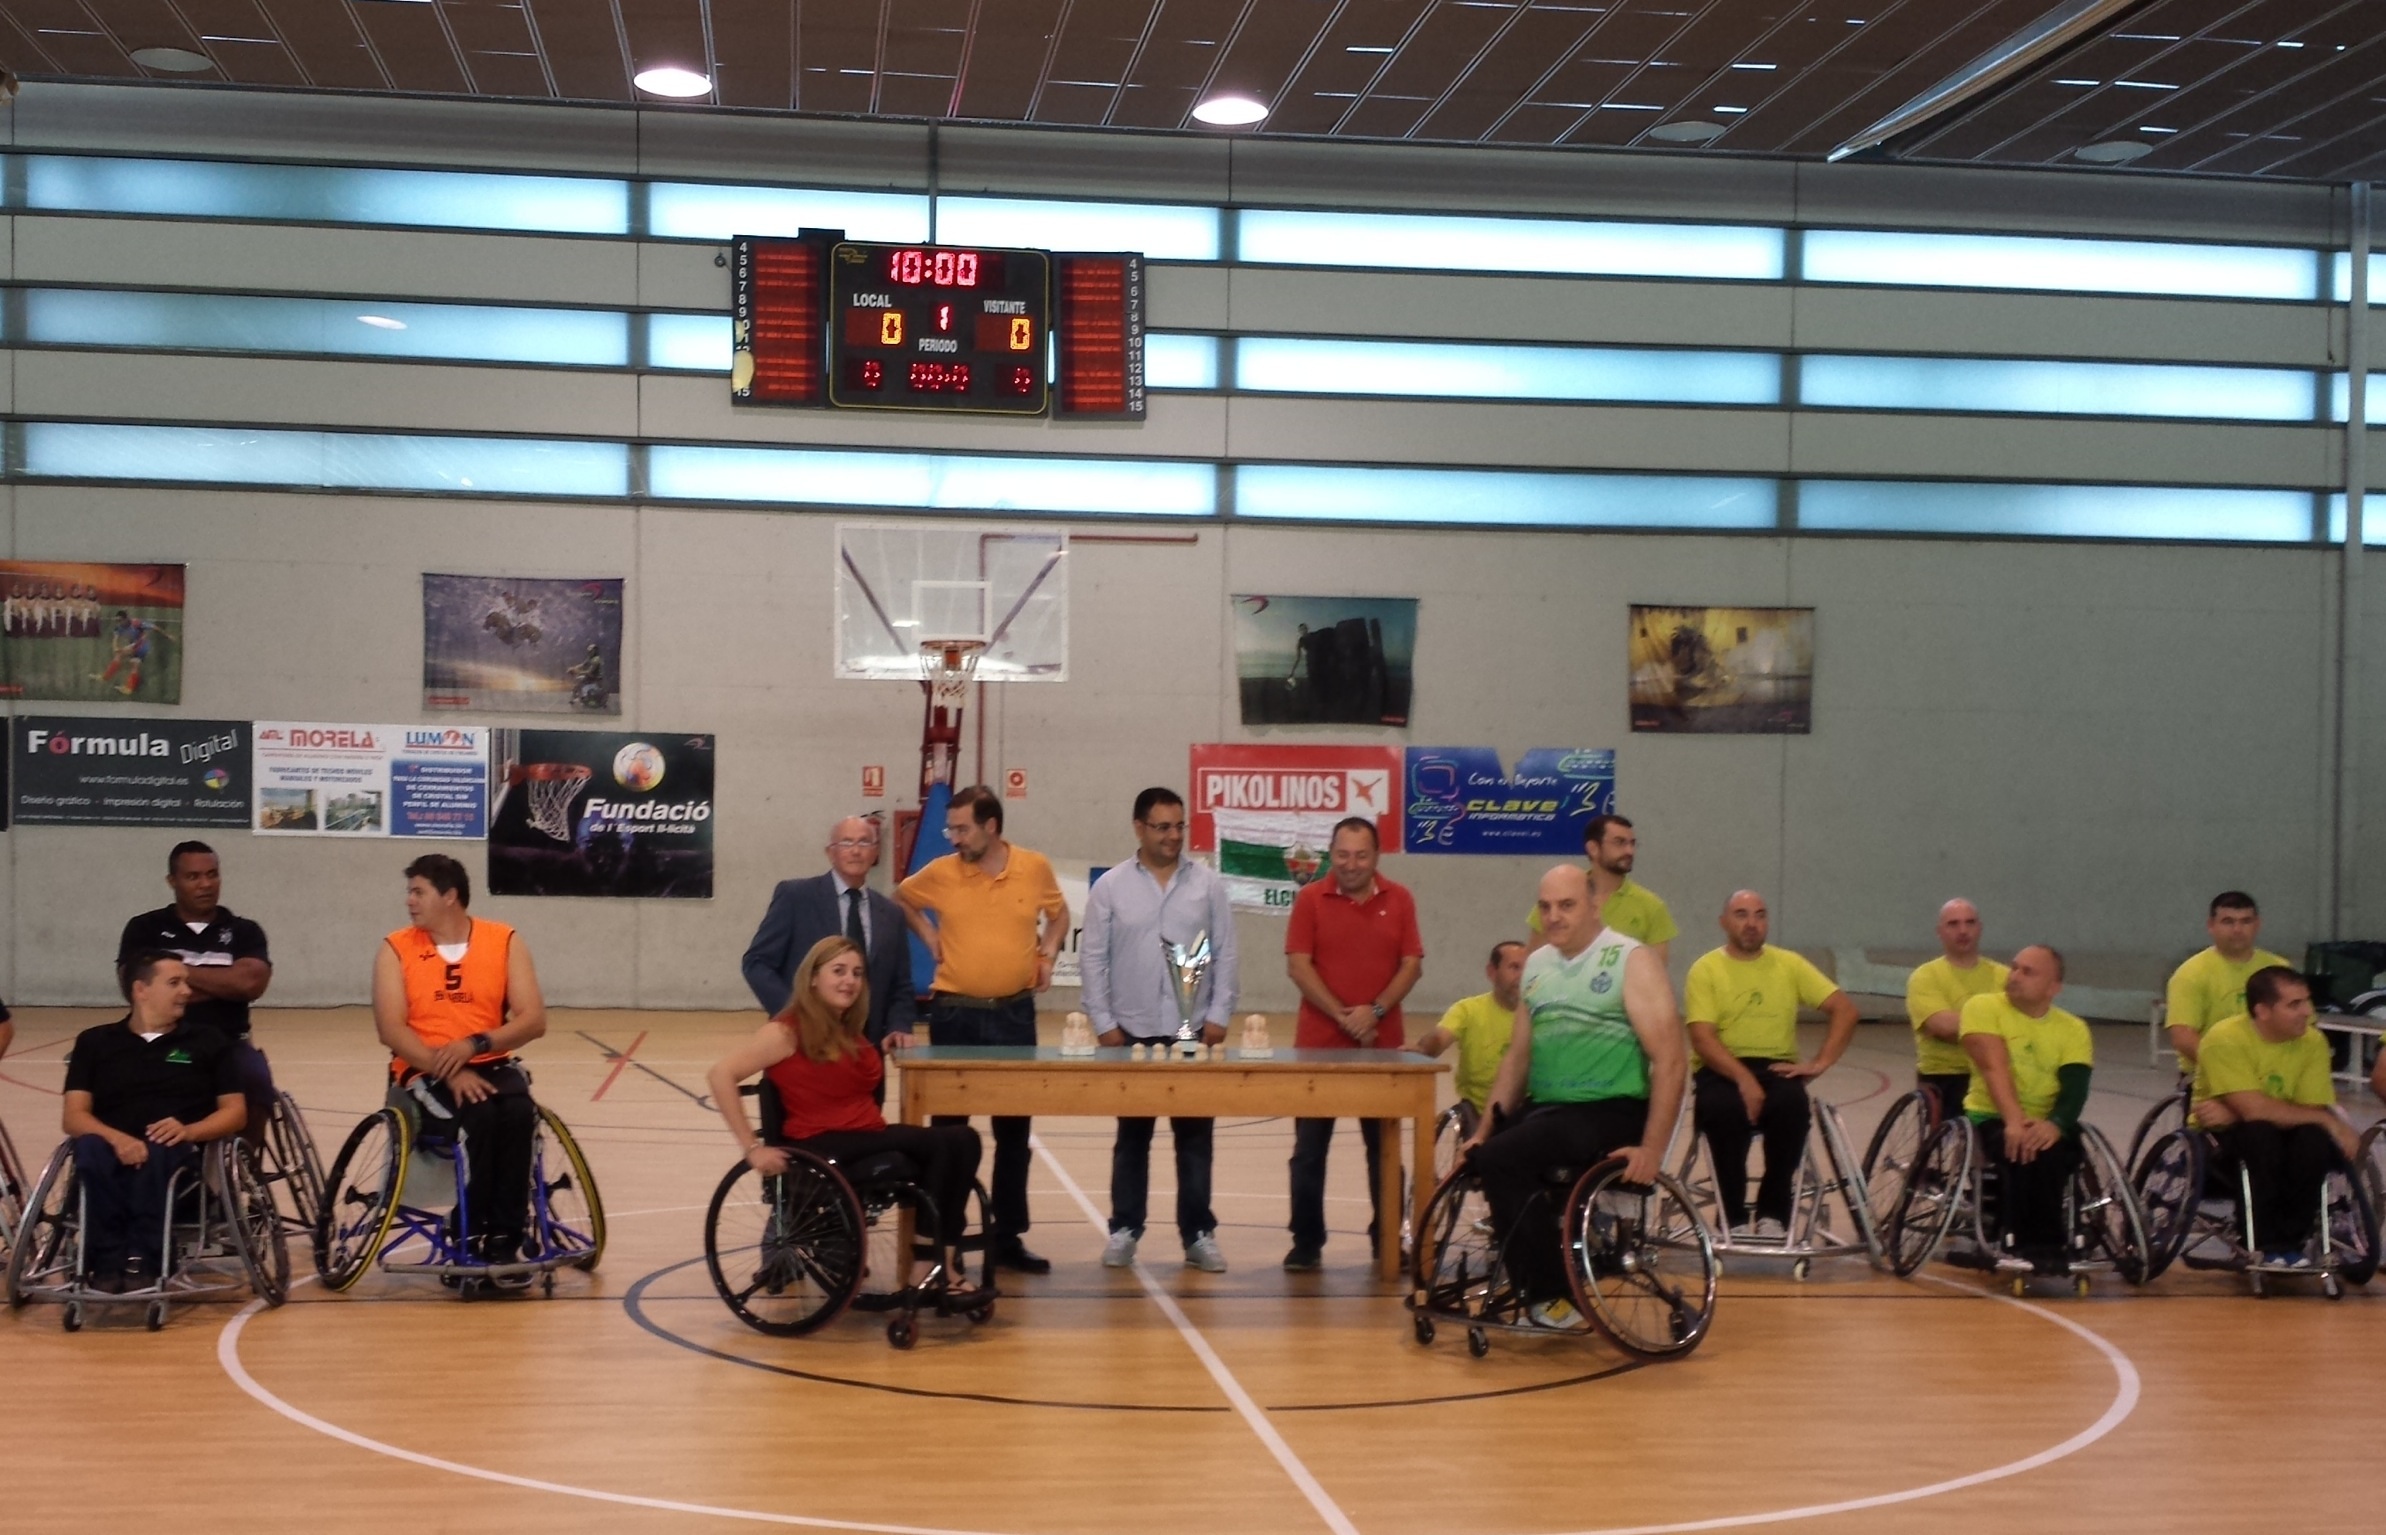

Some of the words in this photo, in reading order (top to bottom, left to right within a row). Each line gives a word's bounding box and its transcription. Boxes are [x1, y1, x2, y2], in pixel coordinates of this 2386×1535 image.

[739, 242, 747, 252] 4
[739, 255, 747, 265] 5
[1129, 258, 1137, 269] 4
[739, 268, 746, 278] 6
[890, 251, 978, 286] 10:00
[1131, 271, 1138, 281] 5
[739, 281, 747, 291] 7
[1130, 286, 1138, 296] 6
[738, 294, 747, 304] 8
[853, 293, 892, 308] LOCAL
[983, 300, 1026, 314] VISITANTE
[1130, 300, 1138, 309] 7
[739, 307, 747, 317] 9
[1130, 312, 1139, 322] 8
[940, 306, 949, 330] 1
[881, 312, 902, 345] 0
[1131, 324, 1139, 335] 9
[1009, 318, 1031, 350] 0
[918, 338, 958, 353] PERIODO
[1128, 337, 1142, 347] 10
[1128, 351, 1141, 360] 11
[1129, 363, 1142, 373] 12
[1129, 376, 1142, 386] 13
[1129, 388, 1142, 398] 14
[1129, 401, 1143, 411] 15
[290, 729, 375, 748] MORELA
[28, 730, 170, 757] Fórmula
[179, 729, 239, 764] Digital
[79, 775, 189, 787] www.formuladigital.es
[1468, 772, 1494, 786] Con
[1207, 774, 1341, 809] PIKOLINOS
[55, 796, 90, 807] gráfico
[151, 797, 181, 809] digital
[583, 798, 710, 821] Fundació
[589, 823, 605, 832] de
[445, 964, 462, 990] 5
